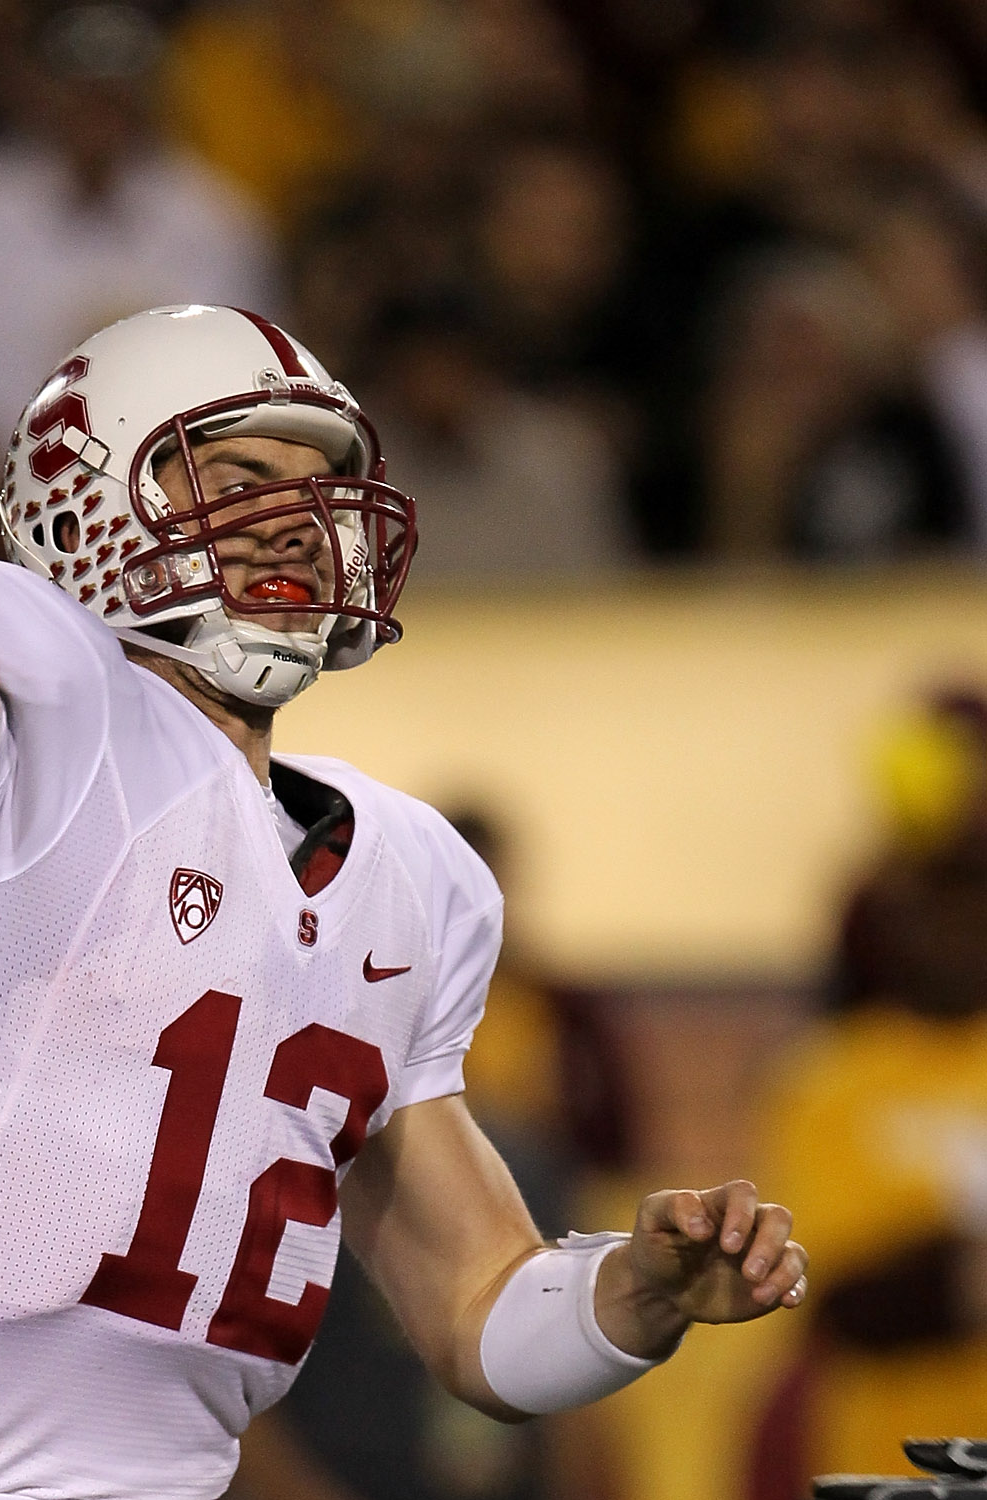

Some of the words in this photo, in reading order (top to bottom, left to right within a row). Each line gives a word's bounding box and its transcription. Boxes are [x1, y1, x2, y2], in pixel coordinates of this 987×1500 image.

[27, 355, 92, 484] S
[343, 543, 367, 596] ddell
[272, 650, 309, 666] Riddell
[173, 872, 221, 921] PAC
[177, 900, 206, 930] 10
[298, 908, 318, 947] S
[78, 988, 390, 1366] 12
